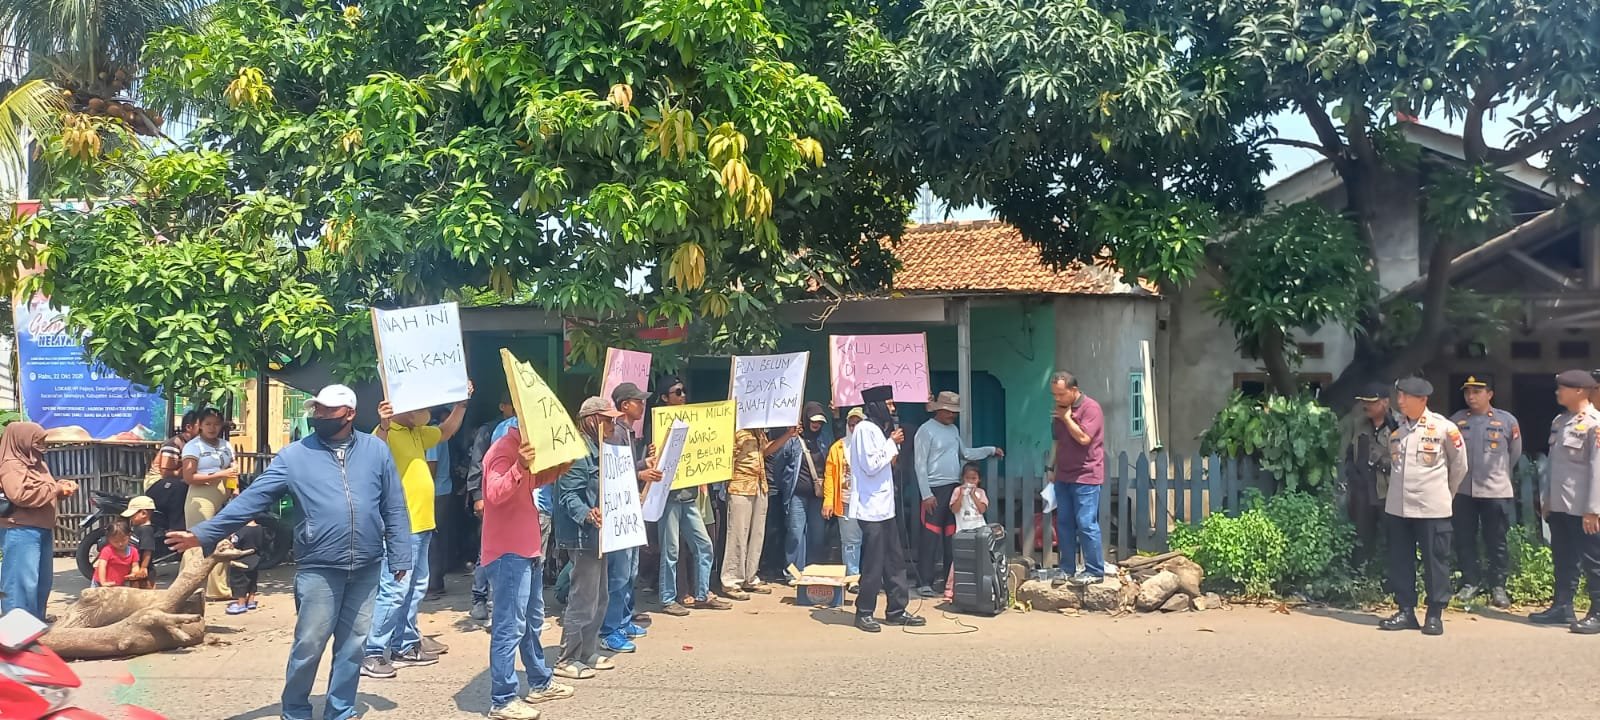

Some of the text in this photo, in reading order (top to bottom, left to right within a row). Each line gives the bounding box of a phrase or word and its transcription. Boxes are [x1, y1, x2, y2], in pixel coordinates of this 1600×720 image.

[880, 342, 925, 354] SUDAH
[760, 358, 790, 371] BELUM
[866, 362, 927, 376] BAYAR
[744, 376, 792, 394] BAYAR
[658, 405, 732, 427] TANAH MILIK
[697, 445, 725, 460] BELUM
